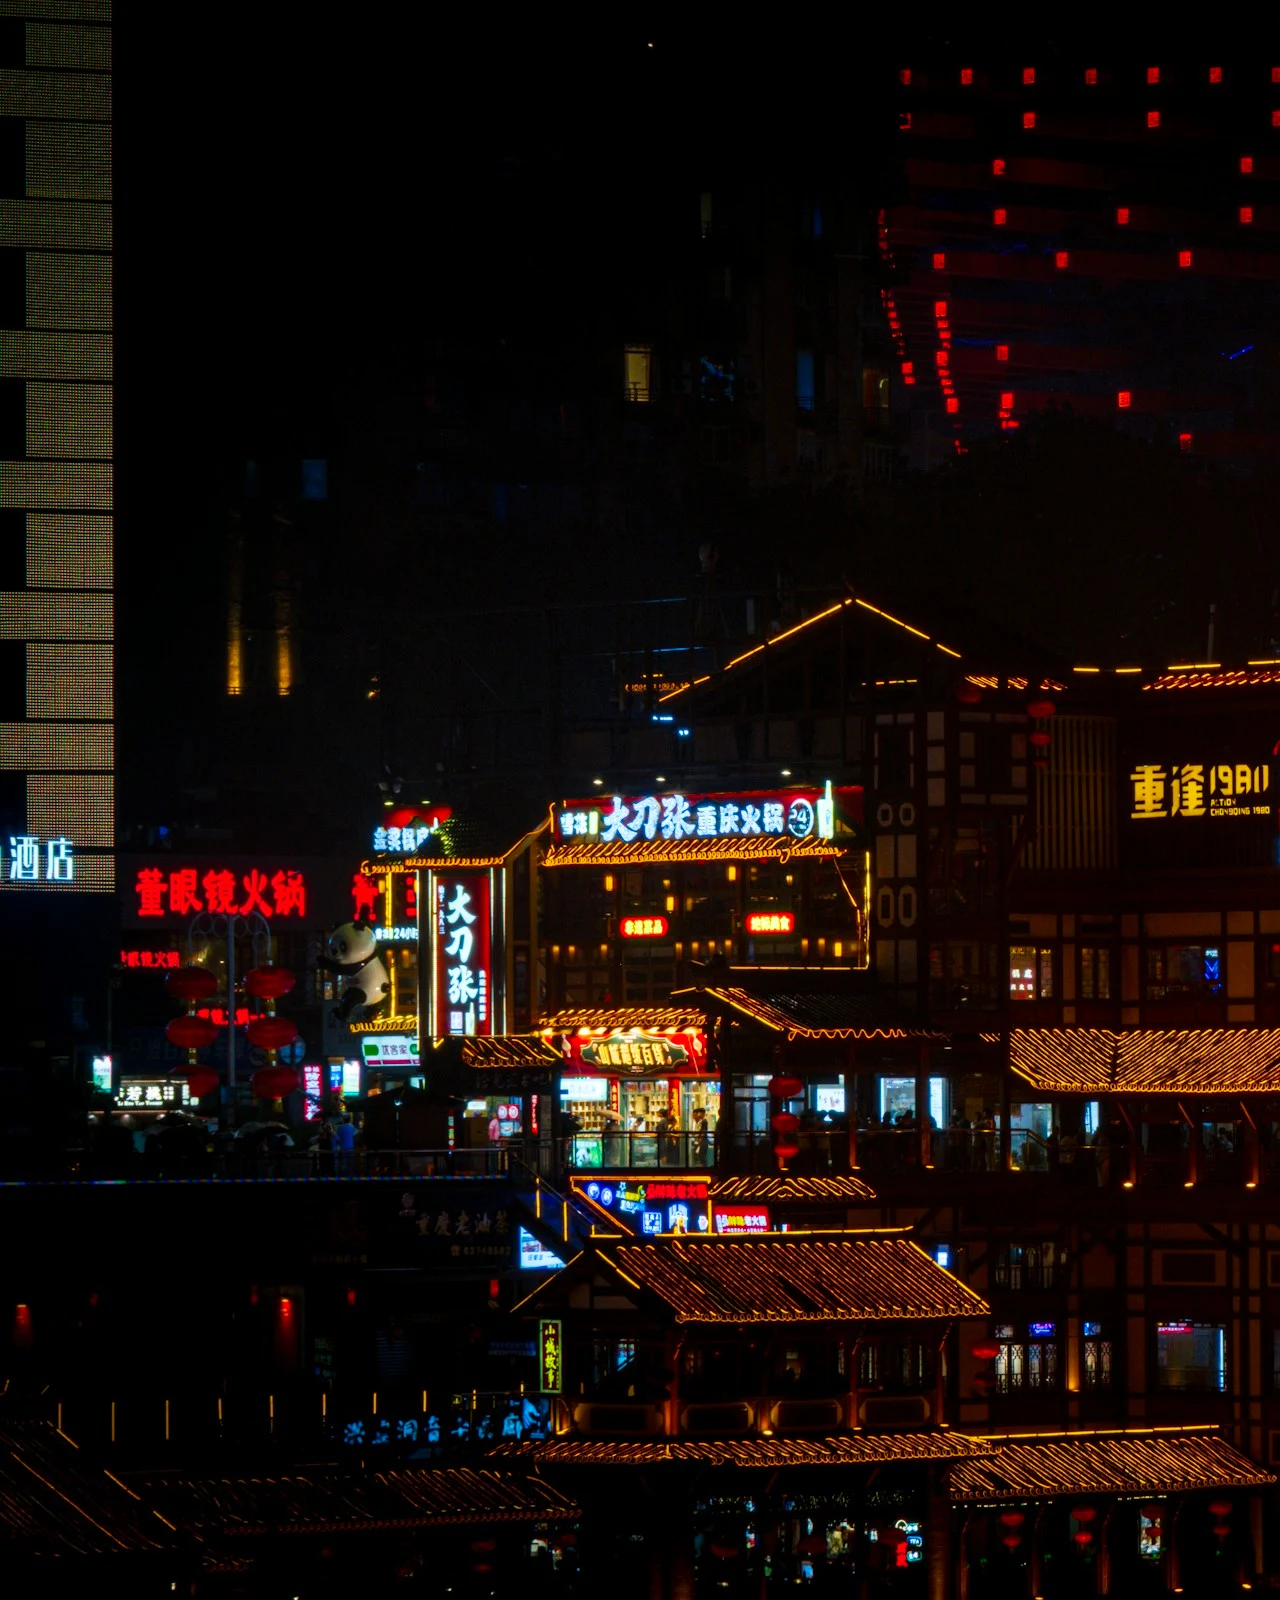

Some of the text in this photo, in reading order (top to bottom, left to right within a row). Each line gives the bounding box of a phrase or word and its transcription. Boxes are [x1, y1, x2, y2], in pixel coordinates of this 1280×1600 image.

[1130, 763, 1206, 819] 重逢
[9, 835, 74, 880] 酒店
[445, 884, 478, 1004] 大刀张
